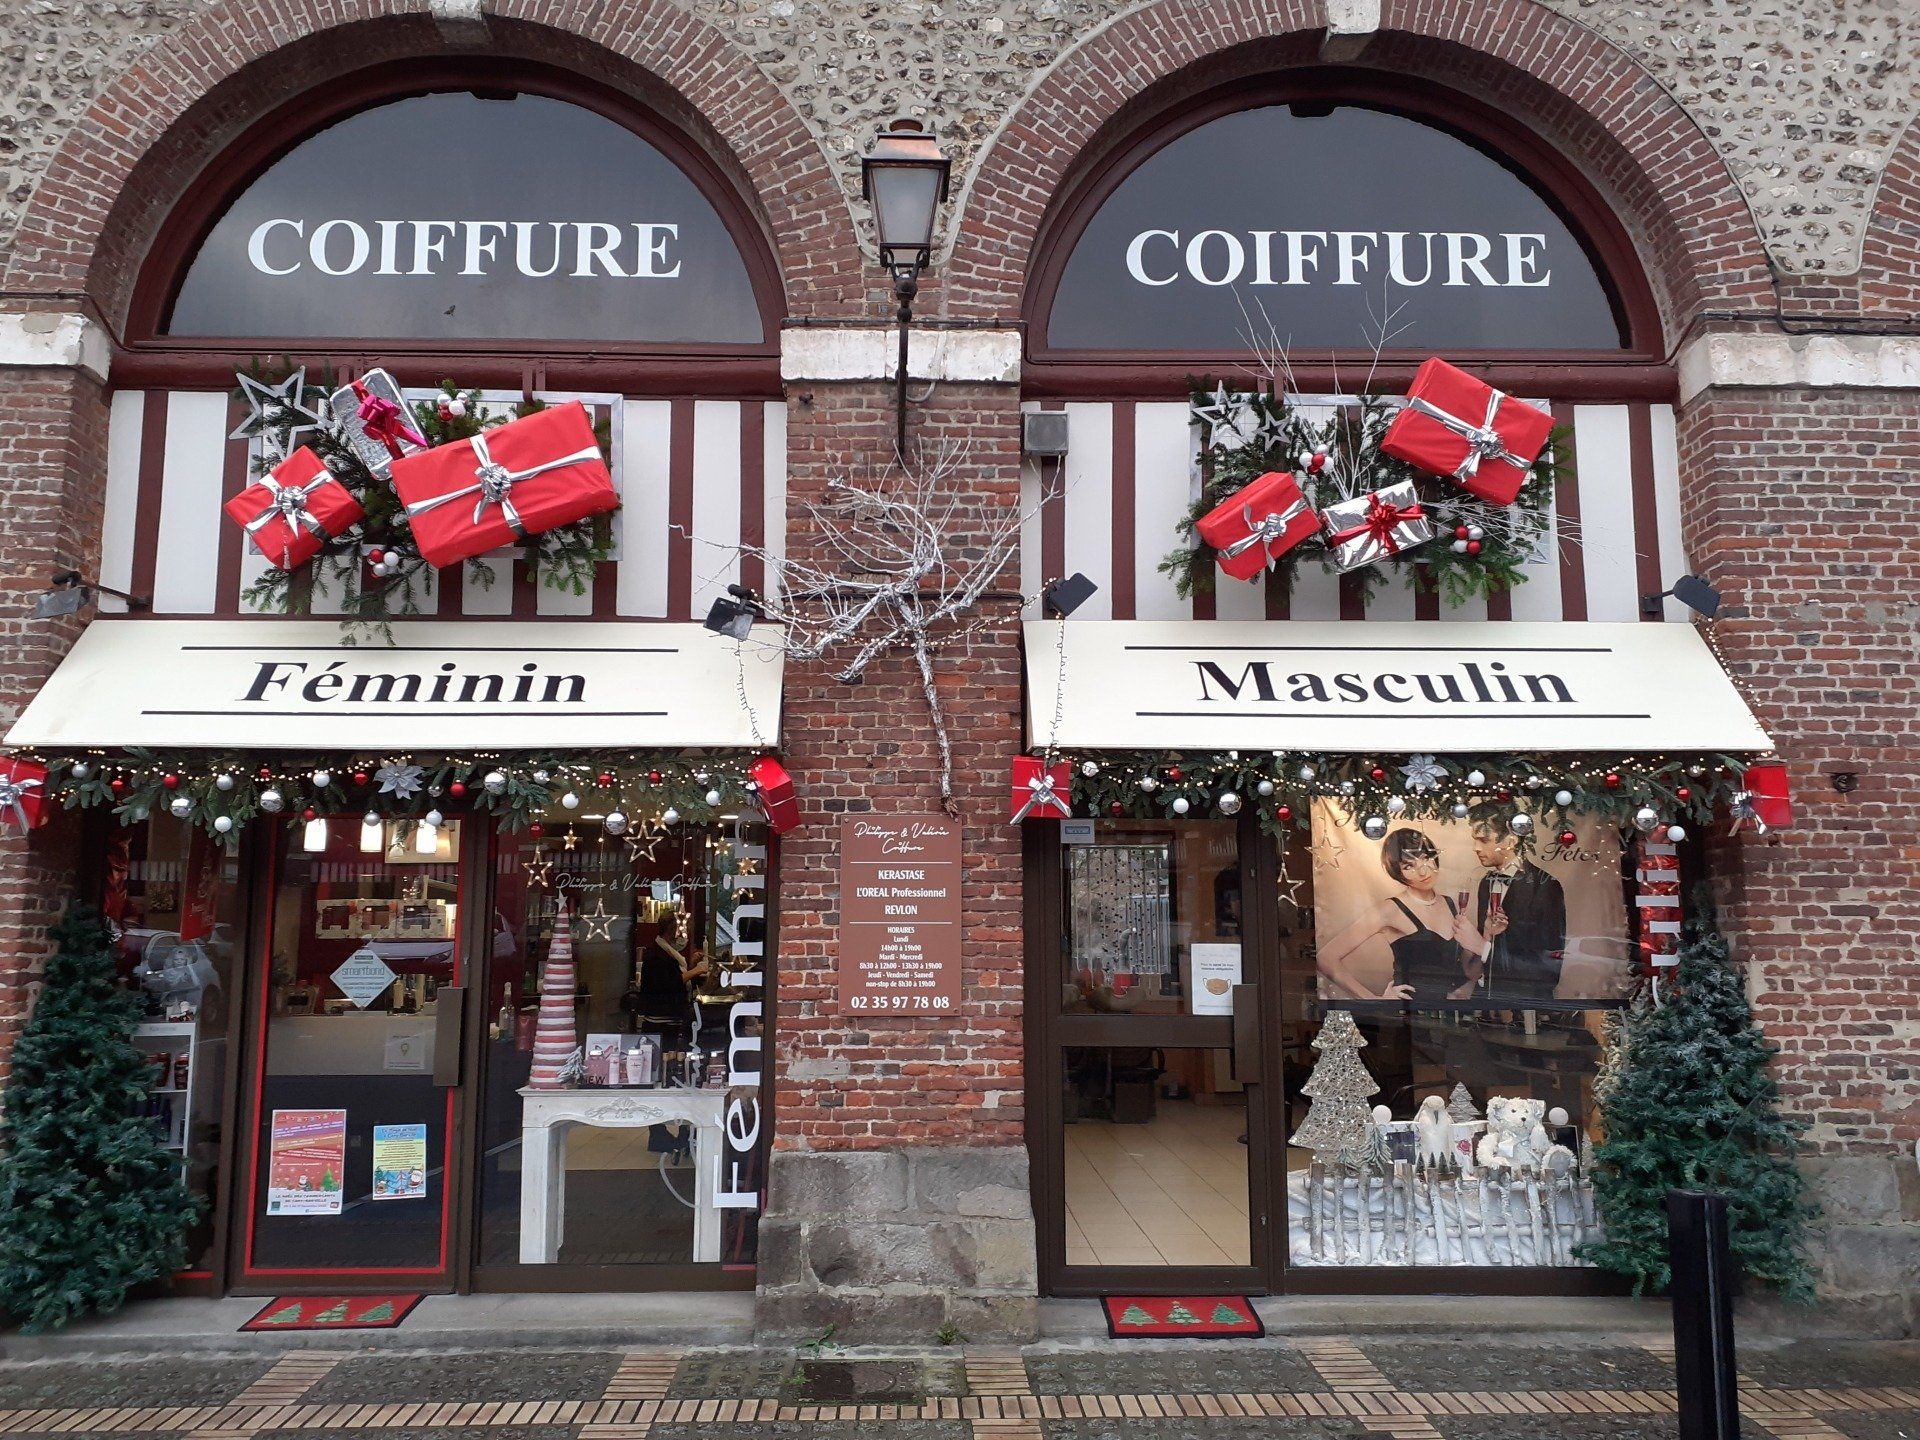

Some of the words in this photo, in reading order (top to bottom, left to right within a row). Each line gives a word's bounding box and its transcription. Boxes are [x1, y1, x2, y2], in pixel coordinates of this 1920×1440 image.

[247, 218, 682, 279] COIFFURE
[1126, 229, 1552, 287] COIFFURE
[234, 661, 587, 703] Féminin
[1188, 660, 1580, 704] Masculin
[854, 821, 899, 838] Philippe
[900, 827, 909, 838] &
[911, 822, 950, 839] Valérie
[882, 838, 925, 854] Coiffure
[878, 870, 925, 880] KERASTASE
[554, 872, 607, 893] Philippe
[609, 878, 619, 891] &
[856, 887, 889, 898] L'OREAL
[891, 887, 946, 898] Professionnel
[884, 905, 918, 915] REVLON
[887, 926, 915, 934] HORAIRES
[893, 935, 909, 943] Lundi
[881, 944, 898, 952] 14h00
[904, 944, 922, 952] 19h00
[859, 962, 874, 970] 8h30
[880, 962, 897, 970] 12h00
[902, 962, 919, 970] 13h30
[925, 962, 943, 970] 19h00
[868, 971, 882, 979] Jeudi
[886, 971, 910, 979] Vendredi
[914, 971, 934, 979] Samedi
[866, 981, 889, 989] non-stop
[898, 980, 913, 988] 8h30
[919, 980, 936, 988] 19h00
[712, 807, 766, 1208] Féminin
[851, 996, 868, 1009] 02
[872, 996, 888, 1009] 35
[892, 996, 909, 1009] 97
[913, 996, 929, 1009] 78
[933, 996, 950, 1009] 08
